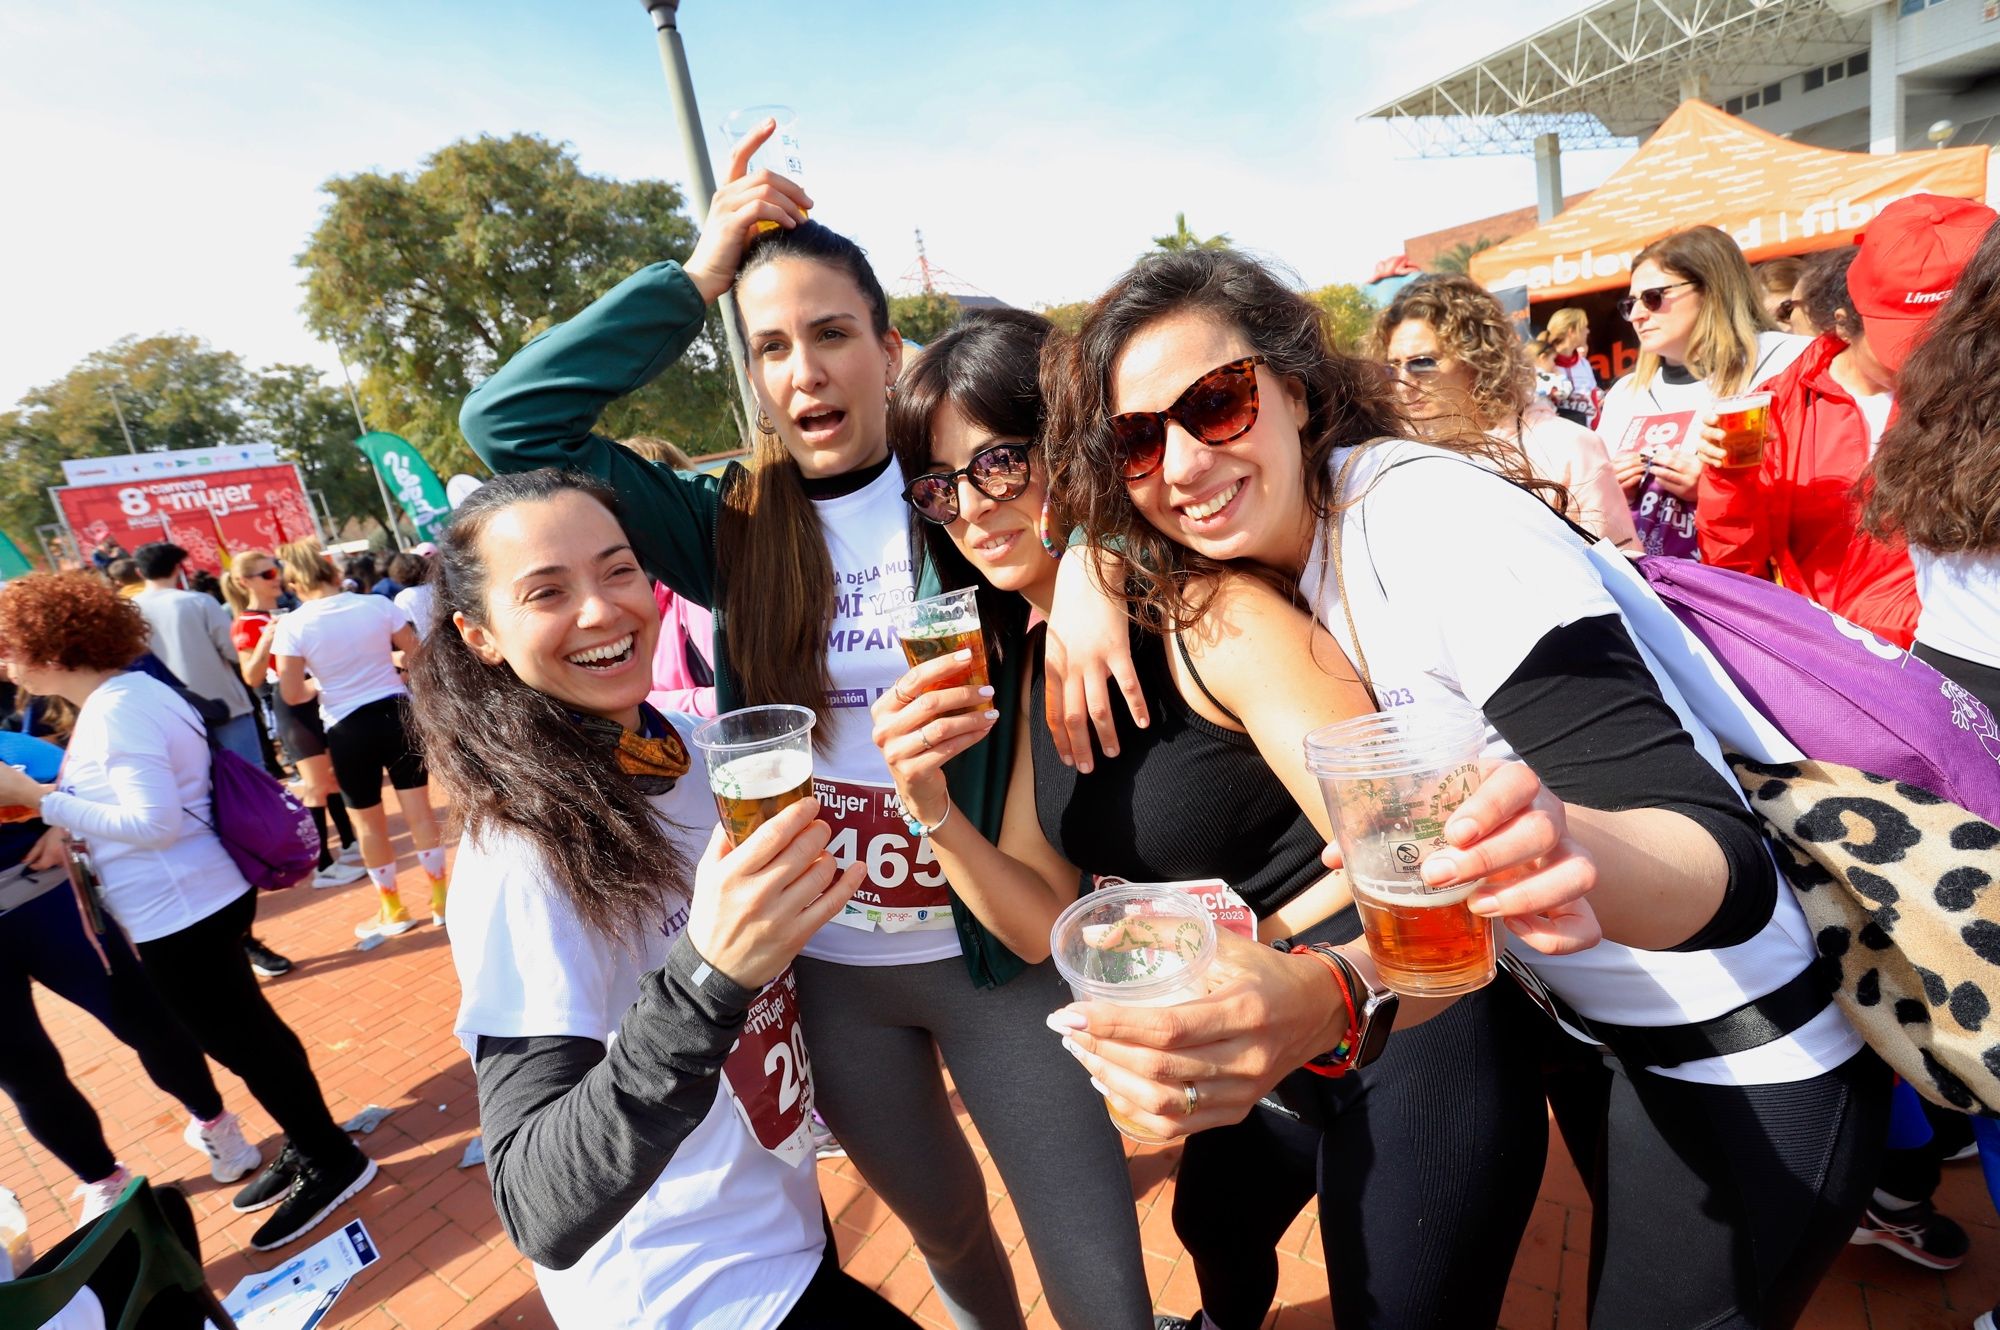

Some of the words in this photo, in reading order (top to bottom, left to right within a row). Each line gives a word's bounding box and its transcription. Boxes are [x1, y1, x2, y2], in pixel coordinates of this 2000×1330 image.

[171, 484, 252, 516] mujer
[814, 791, 869, 820] mujer
[1219, 911, 1245, 920] 2023
[751, 993, 786, 1035] mujer
